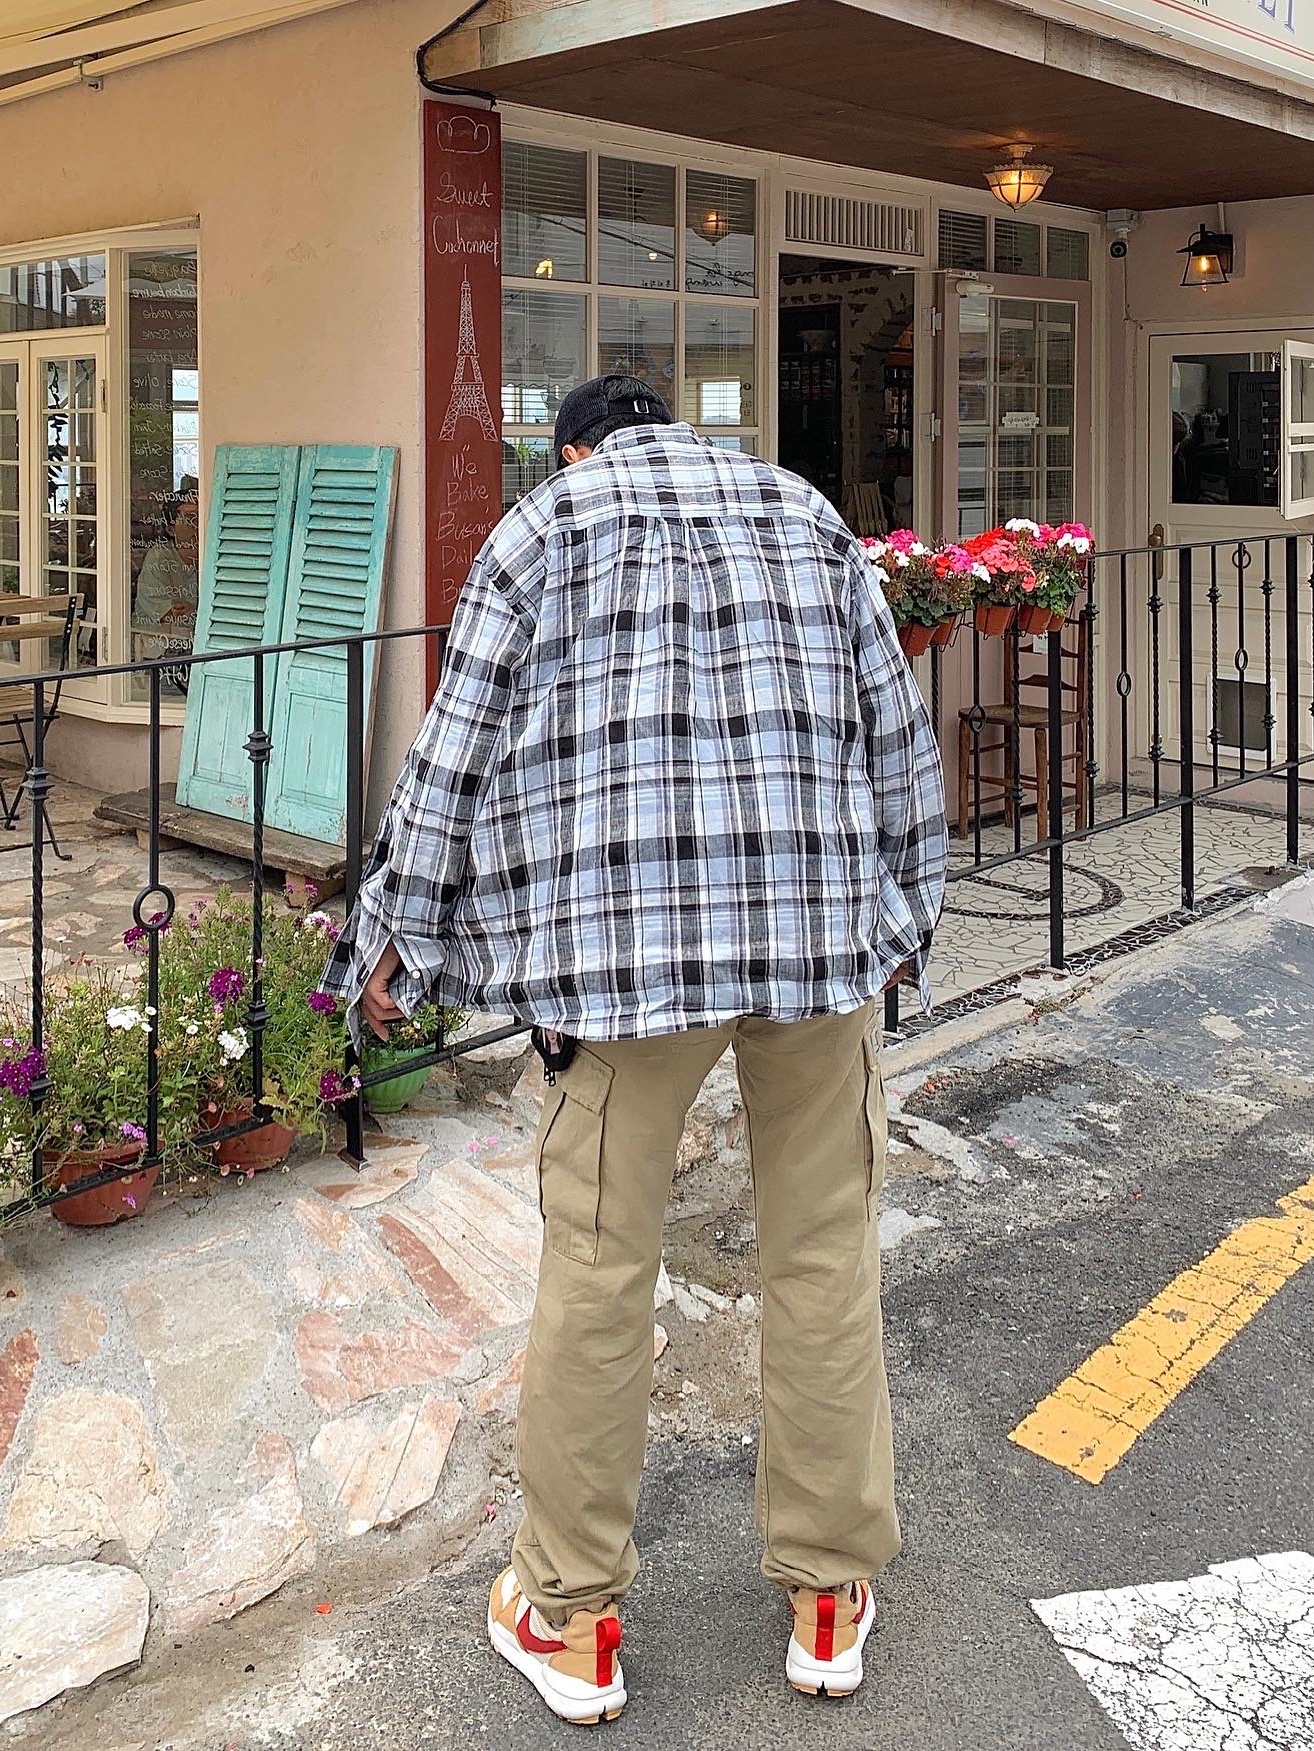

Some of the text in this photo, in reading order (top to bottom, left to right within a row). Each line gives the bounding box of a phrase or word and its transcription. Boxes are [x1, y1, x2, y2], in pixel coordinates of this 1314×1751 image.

[436, 172, 493, 207] Sweet
[446, 478, 489, 506] Bake
[442, 540, 474, 569] Dail
